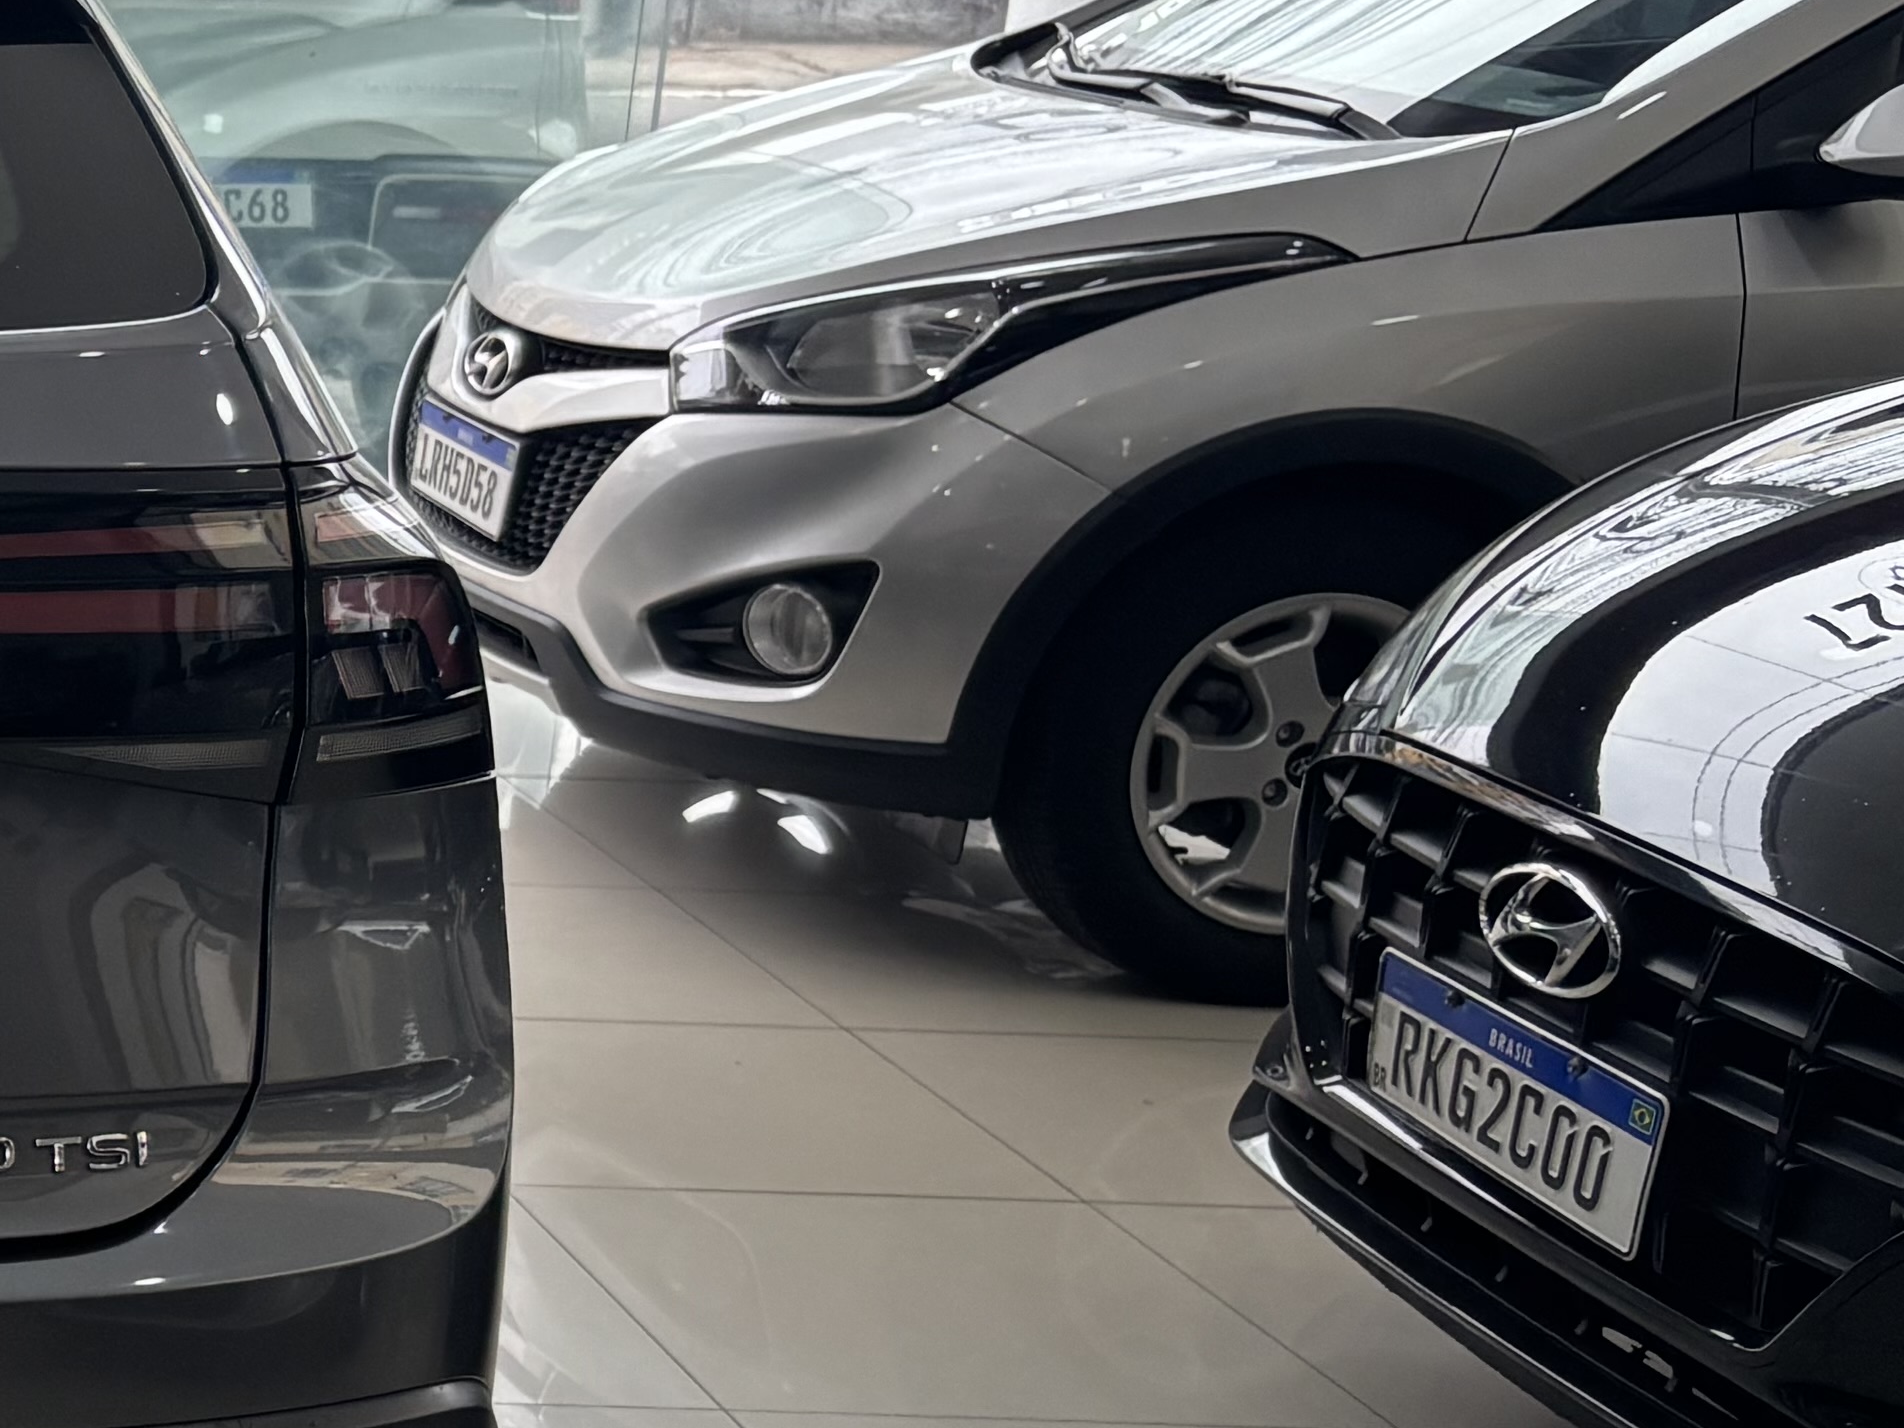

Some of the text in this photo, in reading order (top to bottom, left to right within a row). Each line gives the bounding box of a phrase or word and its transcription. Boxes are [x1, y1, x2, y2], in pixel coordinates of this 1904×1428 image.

[1488, 1027, 1534, 1069] BRASIL
[1372, 1062, 1387, 1093] BR
[1390, 1010, 1613, 1212] RKG2C00
[35, 1130, 148, 1172] TSI
